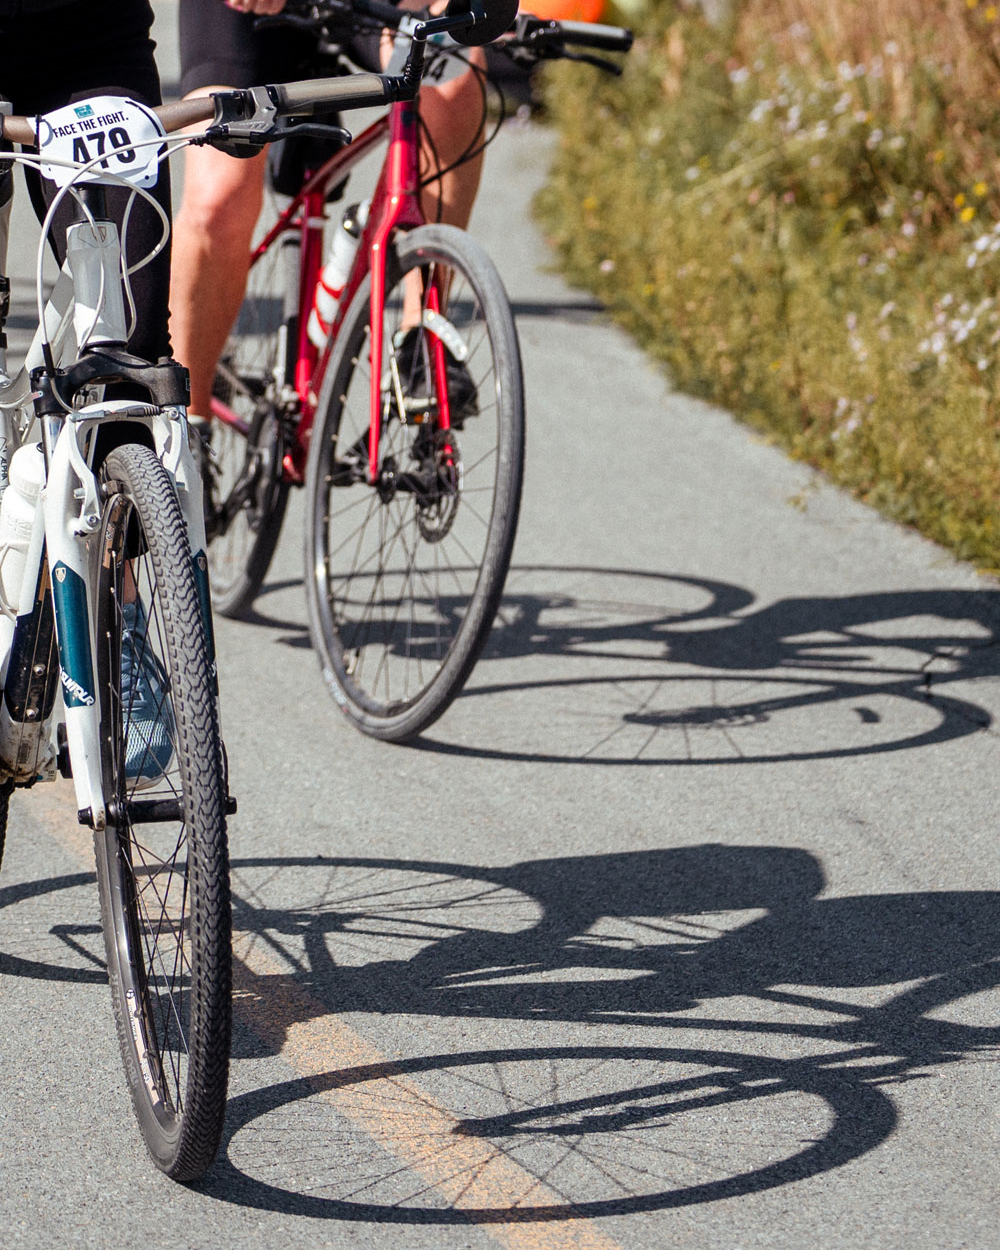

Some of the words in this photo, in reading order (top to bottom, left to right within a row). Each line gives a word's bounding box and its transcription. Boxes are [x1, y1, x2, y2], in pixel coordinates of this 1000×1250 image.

[52, 123, 77, 138] FACE
[76, 116, 97, 132] THE
[97, 111, 129, 127] FIGHT.
[0, 456, 9, 481] ALPHA
